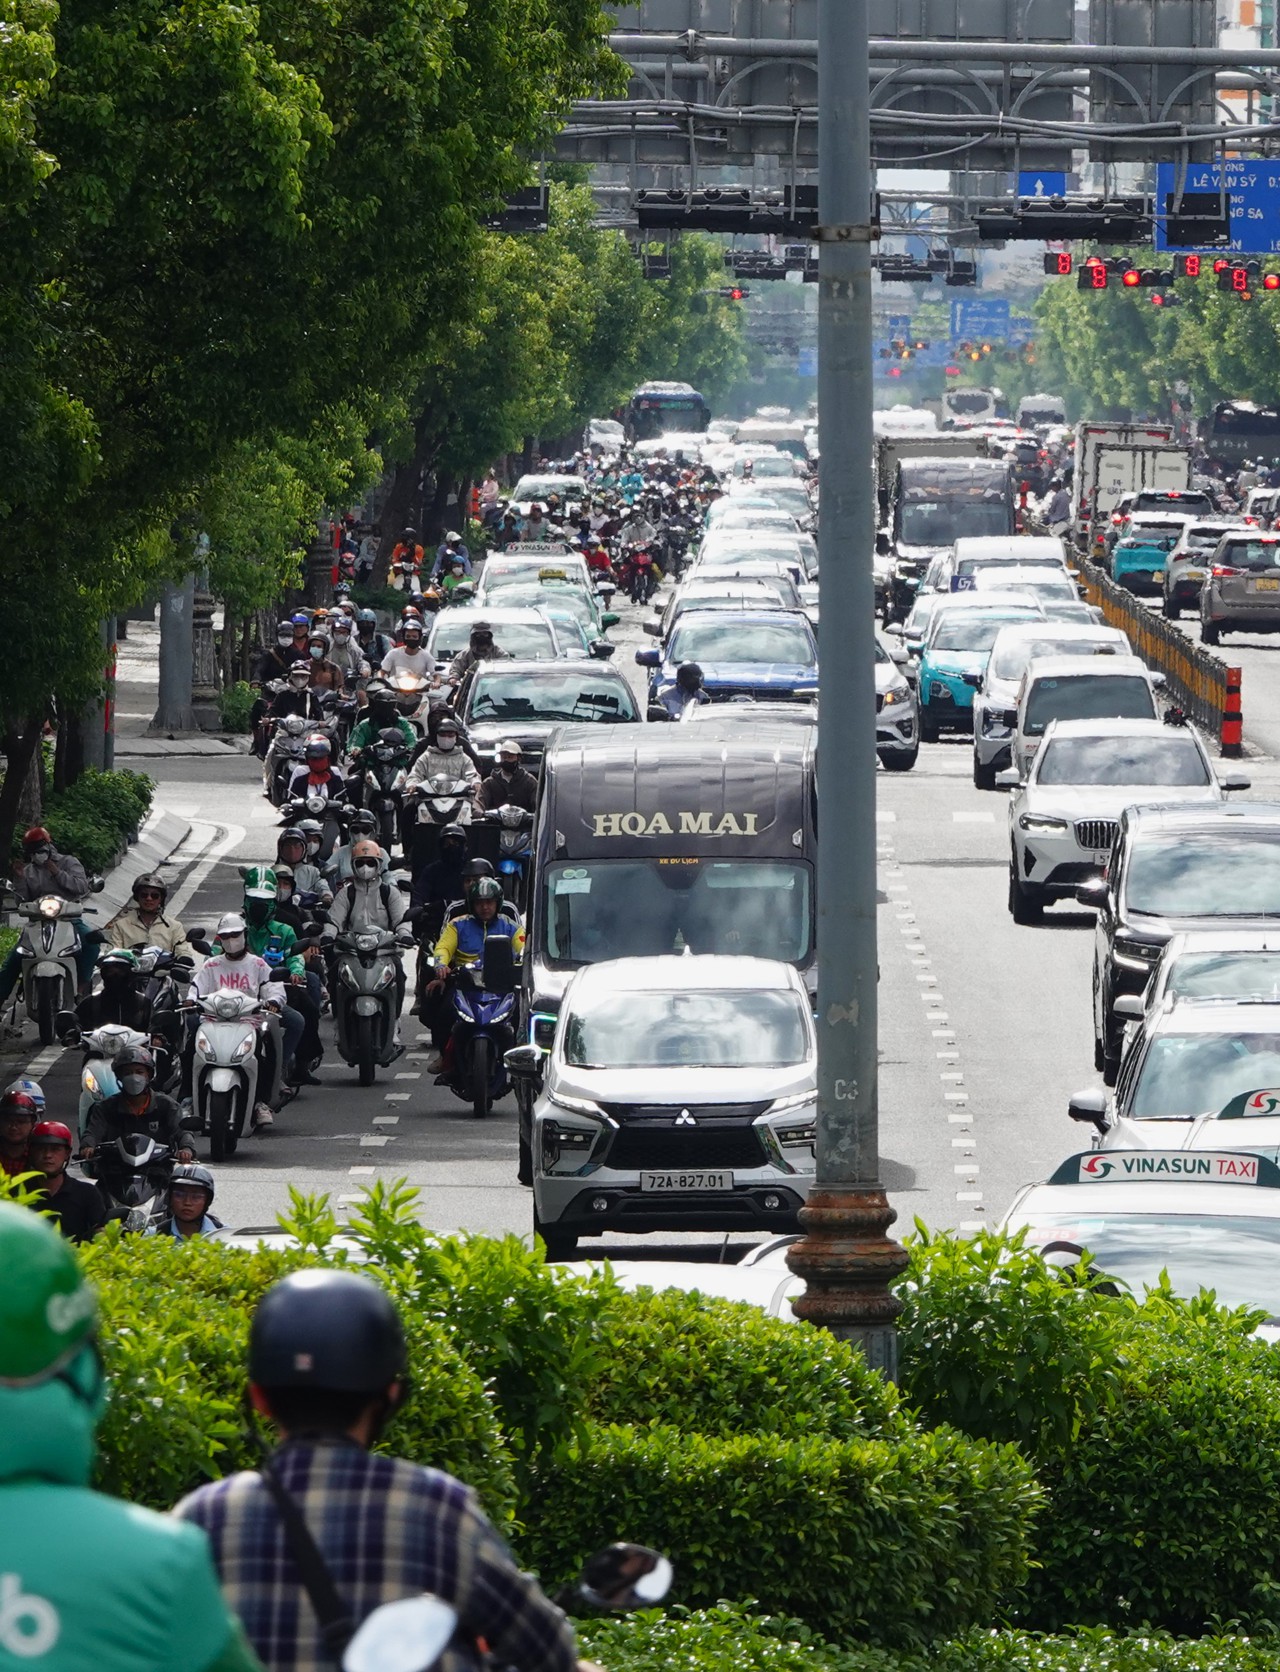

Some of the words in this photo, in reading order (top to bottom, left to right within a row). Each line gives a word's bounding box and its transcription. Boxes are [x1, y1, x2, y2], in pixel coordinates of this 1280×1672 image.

[1247, 208, 1263, 220] SA
[593, 811, 674, 837] HOA
[678, 811, 758, 836] MAI
[1122, 1157, 1210, 1175] VINASUN
[1216, 1159, 1256, 1178] TAXI
[648, 1175, 724, 1188] 72A-827.01
